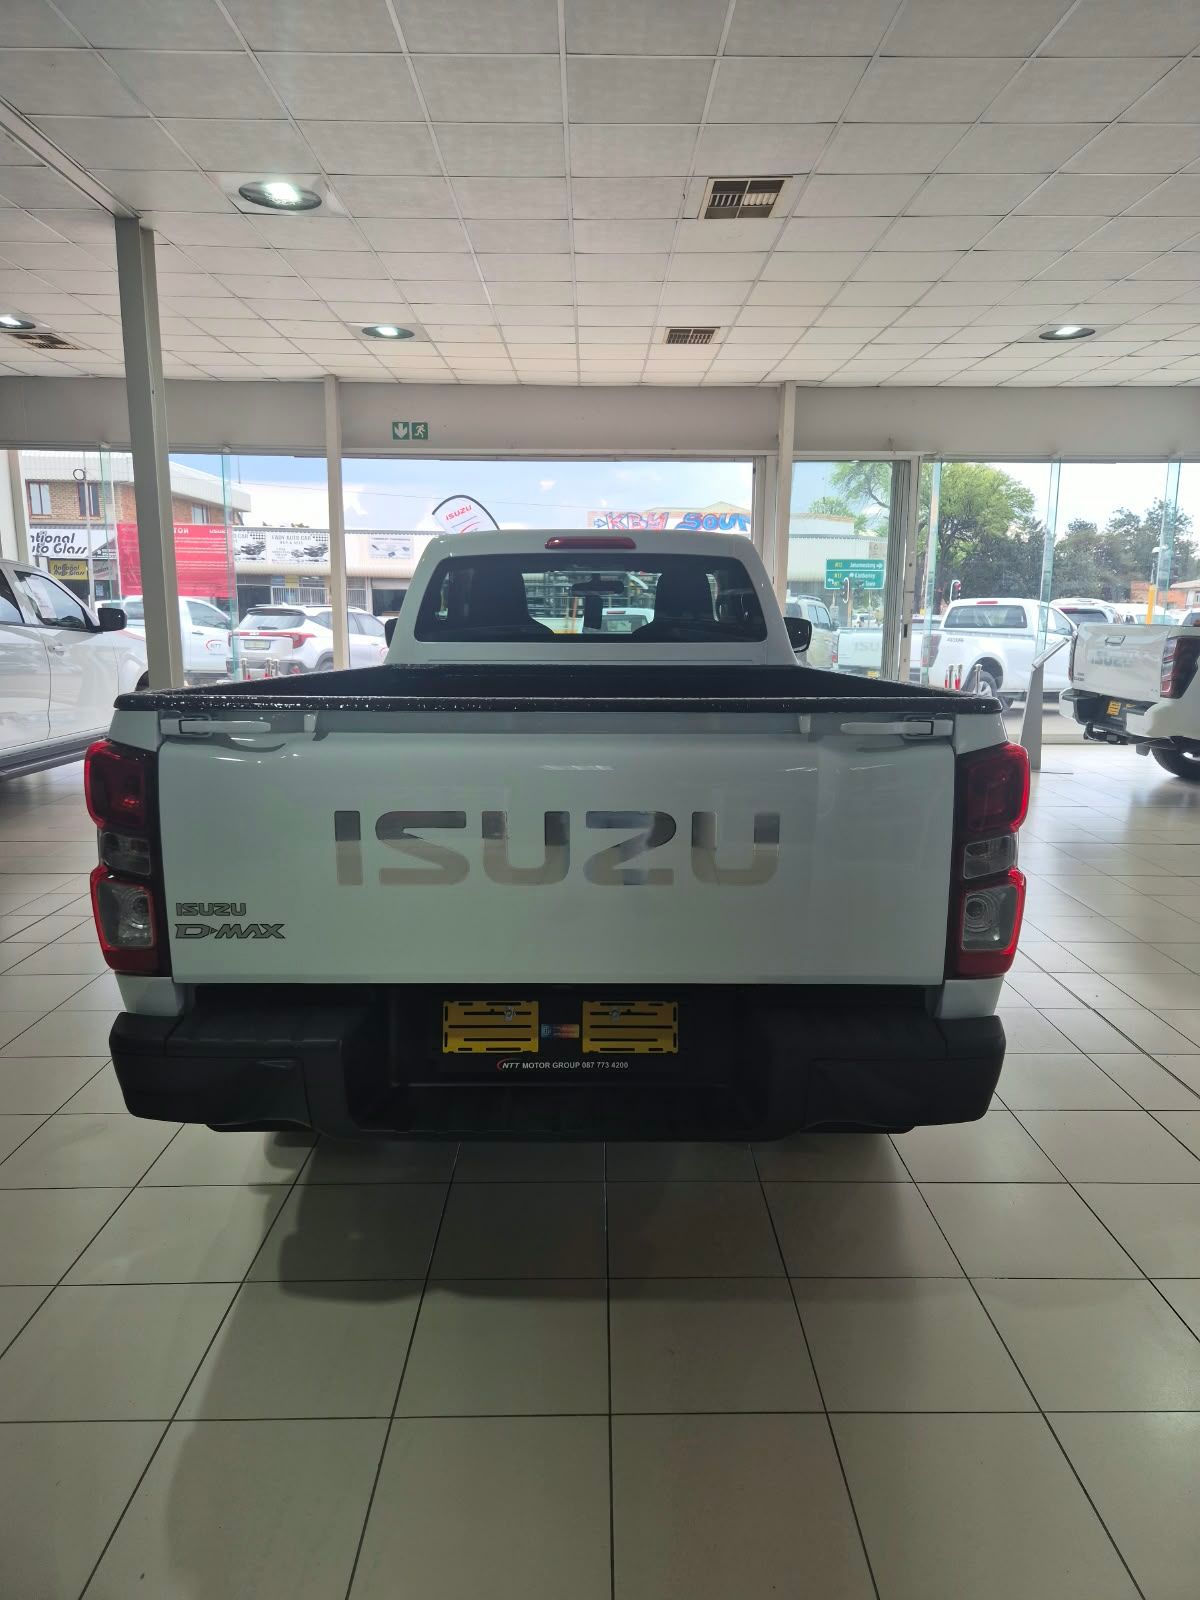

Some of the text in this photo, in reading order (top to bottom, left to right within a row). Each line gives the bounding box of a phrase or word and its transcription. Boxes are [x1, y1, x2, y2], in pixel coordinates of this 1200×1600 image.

[445, 504, 472, 521] ISUZU
[53, 543, 87, 554] Glass
[333, 810, 781, 886] ISUZU
[175, 902, 247, 917] ISUZU
[502, 1061, 629, 1069] NTT MOTOR GROUP 087 773 4200
